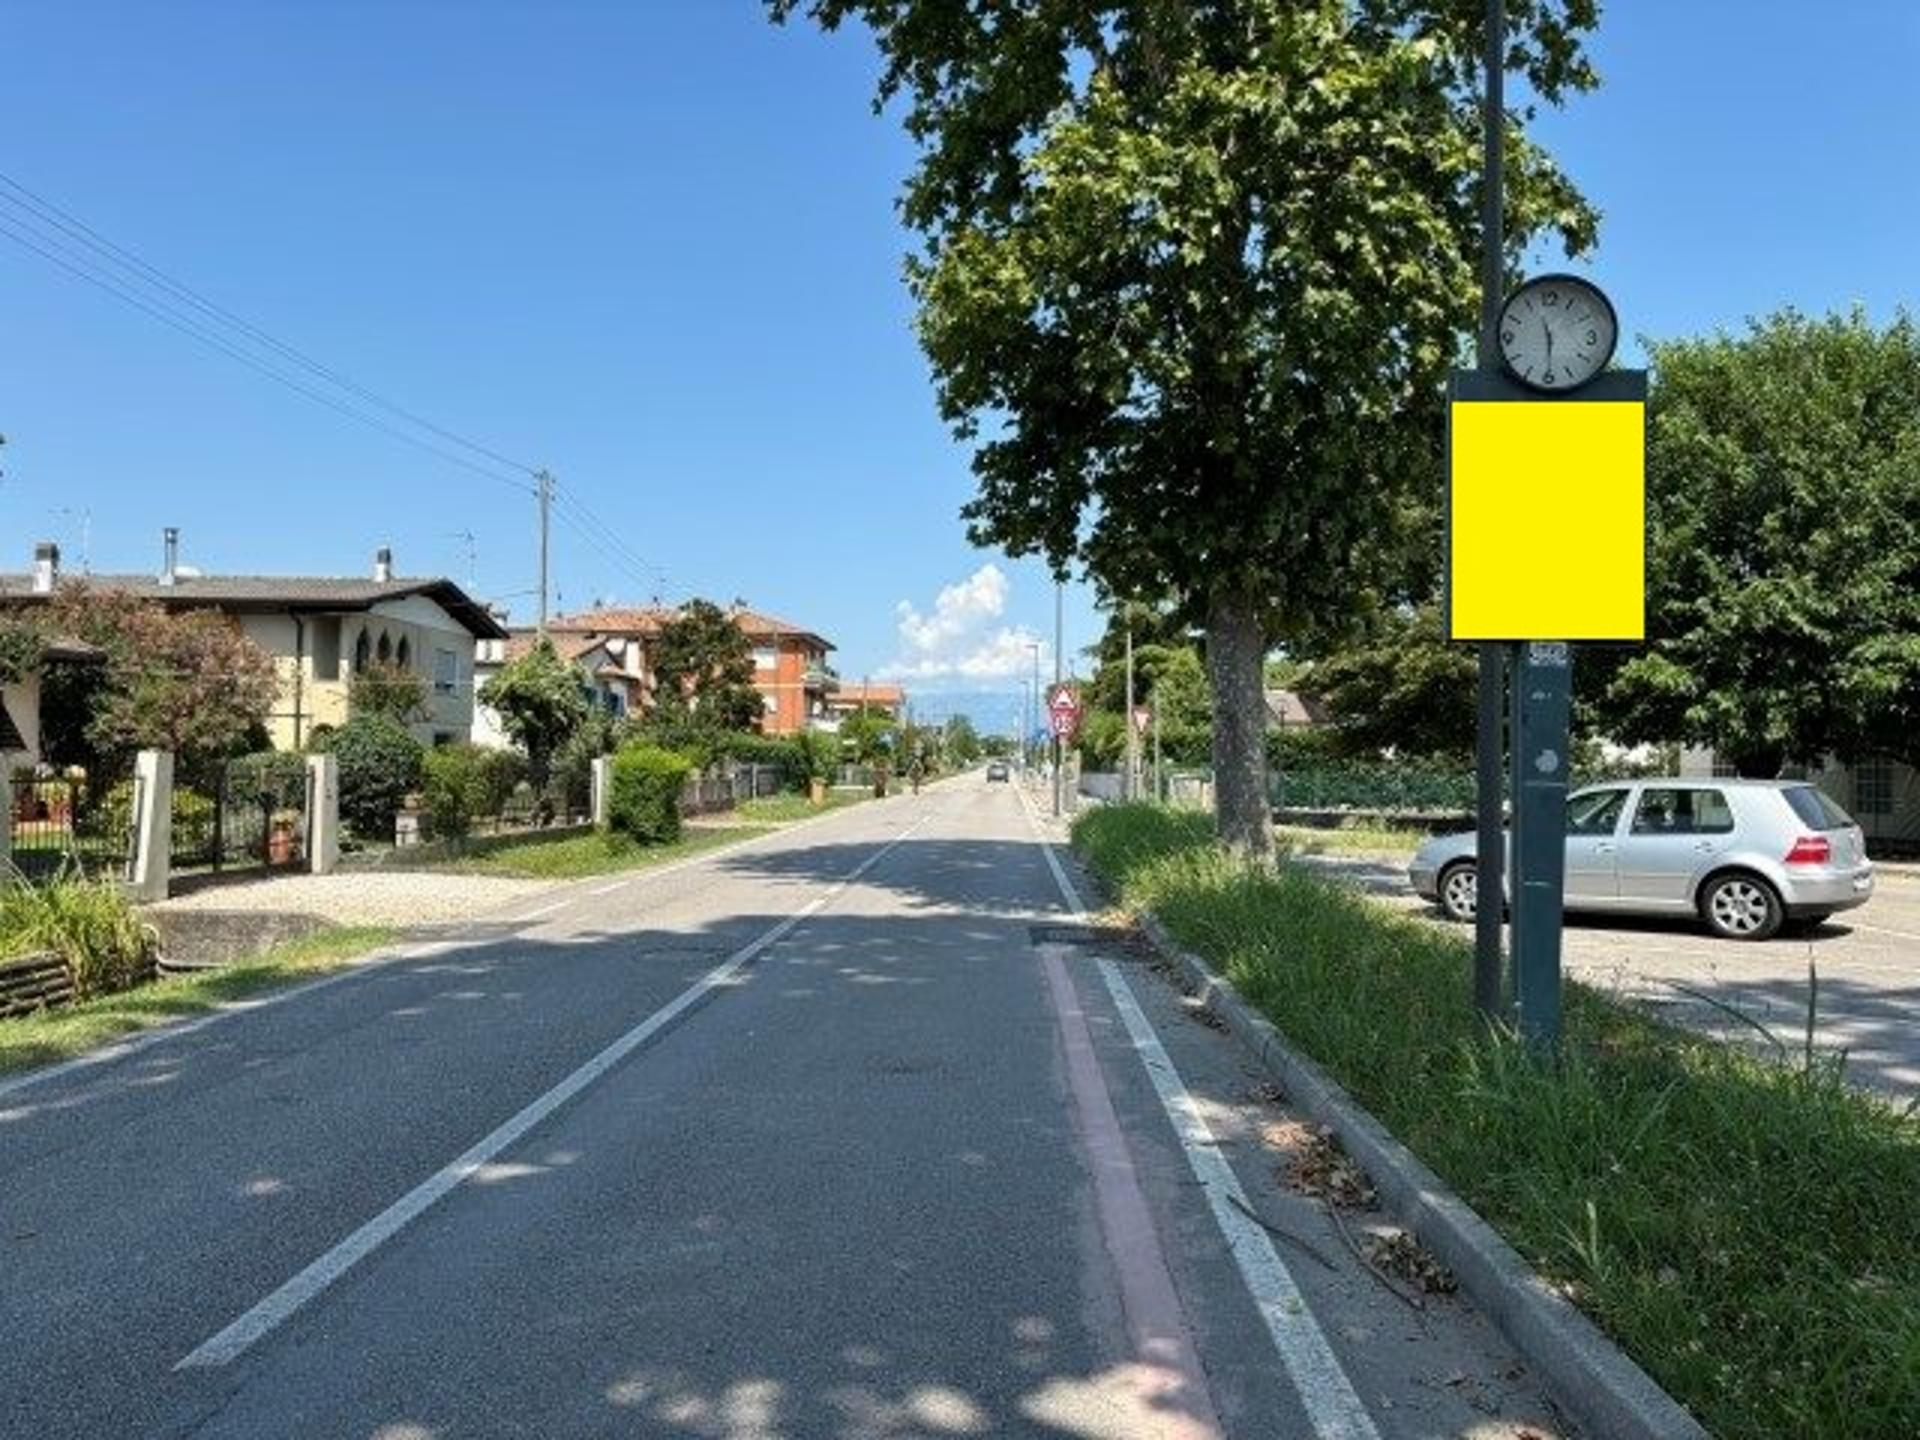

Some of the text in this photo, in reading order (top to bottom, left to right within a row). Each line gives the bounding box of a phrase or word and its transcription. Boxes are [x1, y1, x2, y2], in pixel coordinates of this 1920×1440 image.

[1541, 290, 1557, 306] 12
[1585, 329, 1597, 345] 3
[1542, 368, 1554, 384] 6
